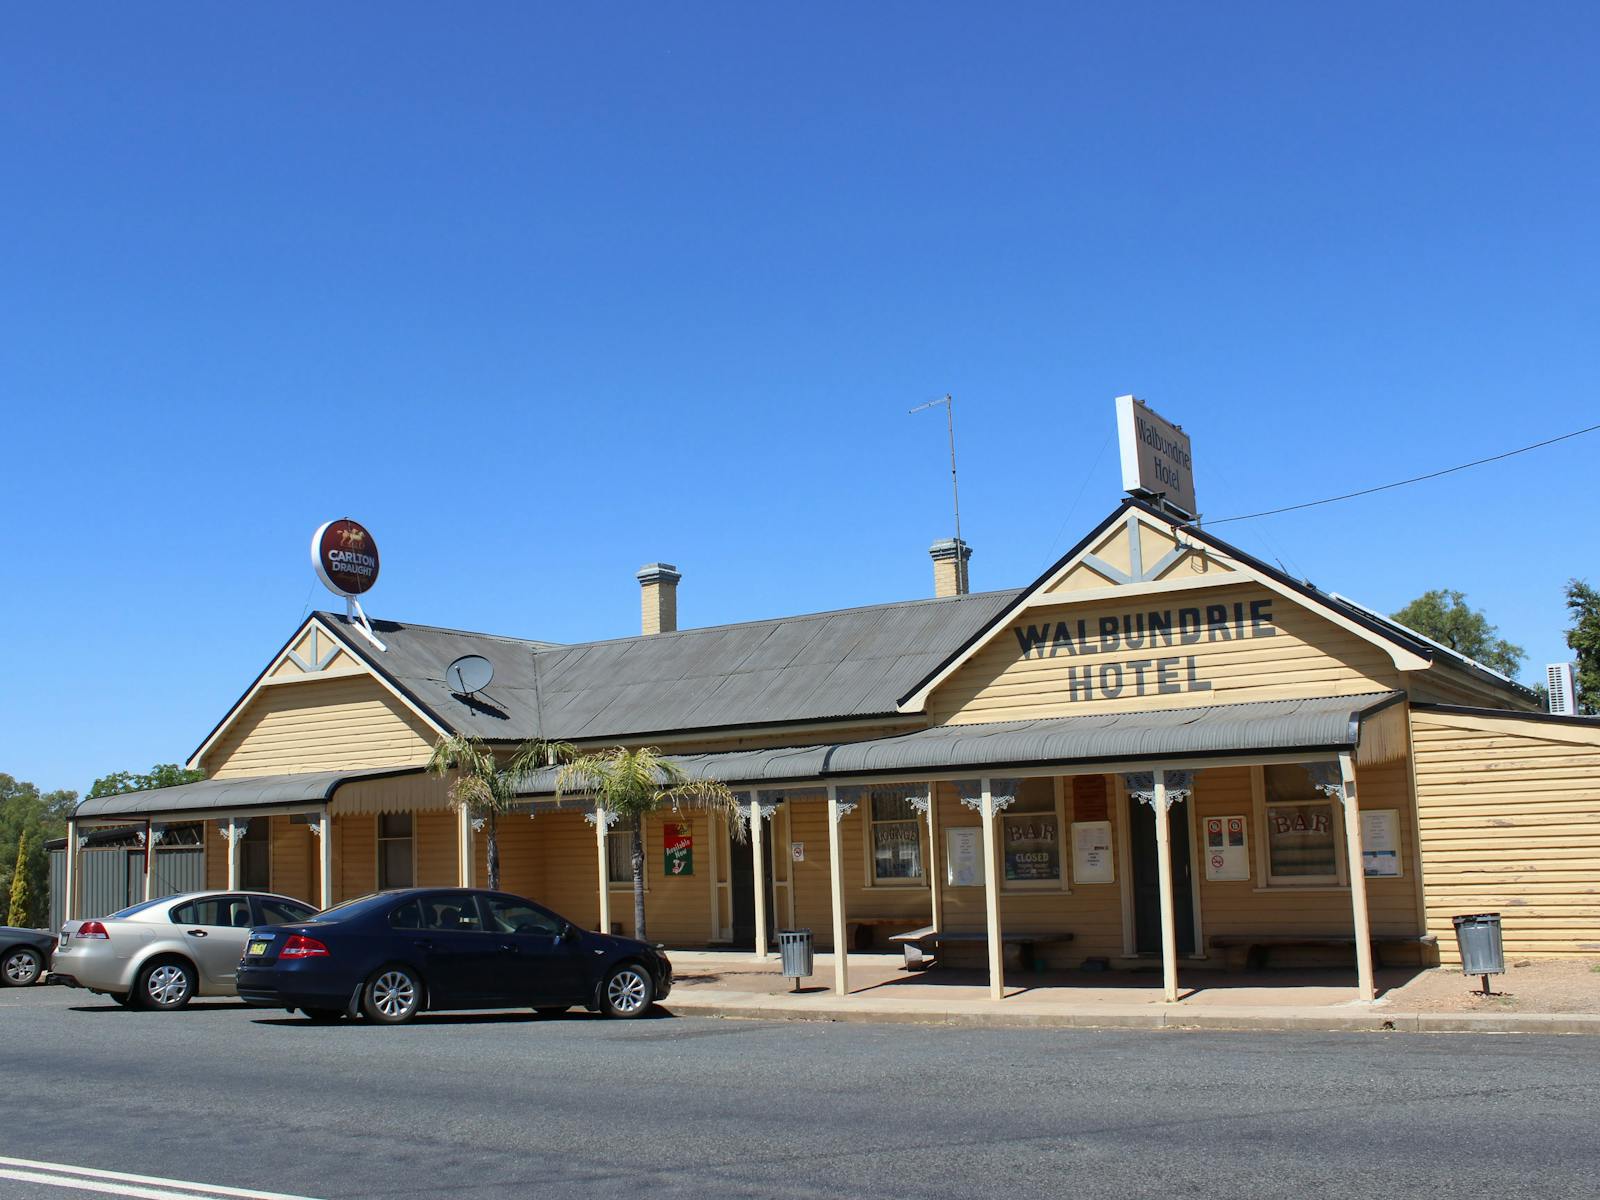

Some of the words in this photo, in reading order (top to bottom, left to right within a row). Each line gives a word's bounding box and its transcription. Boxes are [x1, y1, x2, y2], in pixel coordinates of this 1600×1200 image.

[1136, 416, 1191, 471] Walbundrie
[1154, 456, 1180, 492] Hotel
[328, 549, 375, 568] CARLTON
[332, 561, 373, 577] DRAUGHT
[1014, 599, 1276, 660] WALBUNDRIE
[1068, 655, 1212, 702] HOTEL
[1008, 823, 1056, 842] BAR
[1272, 814, 1330, 835] BAR
[1015, 852, 1049, 863] CLOSED
